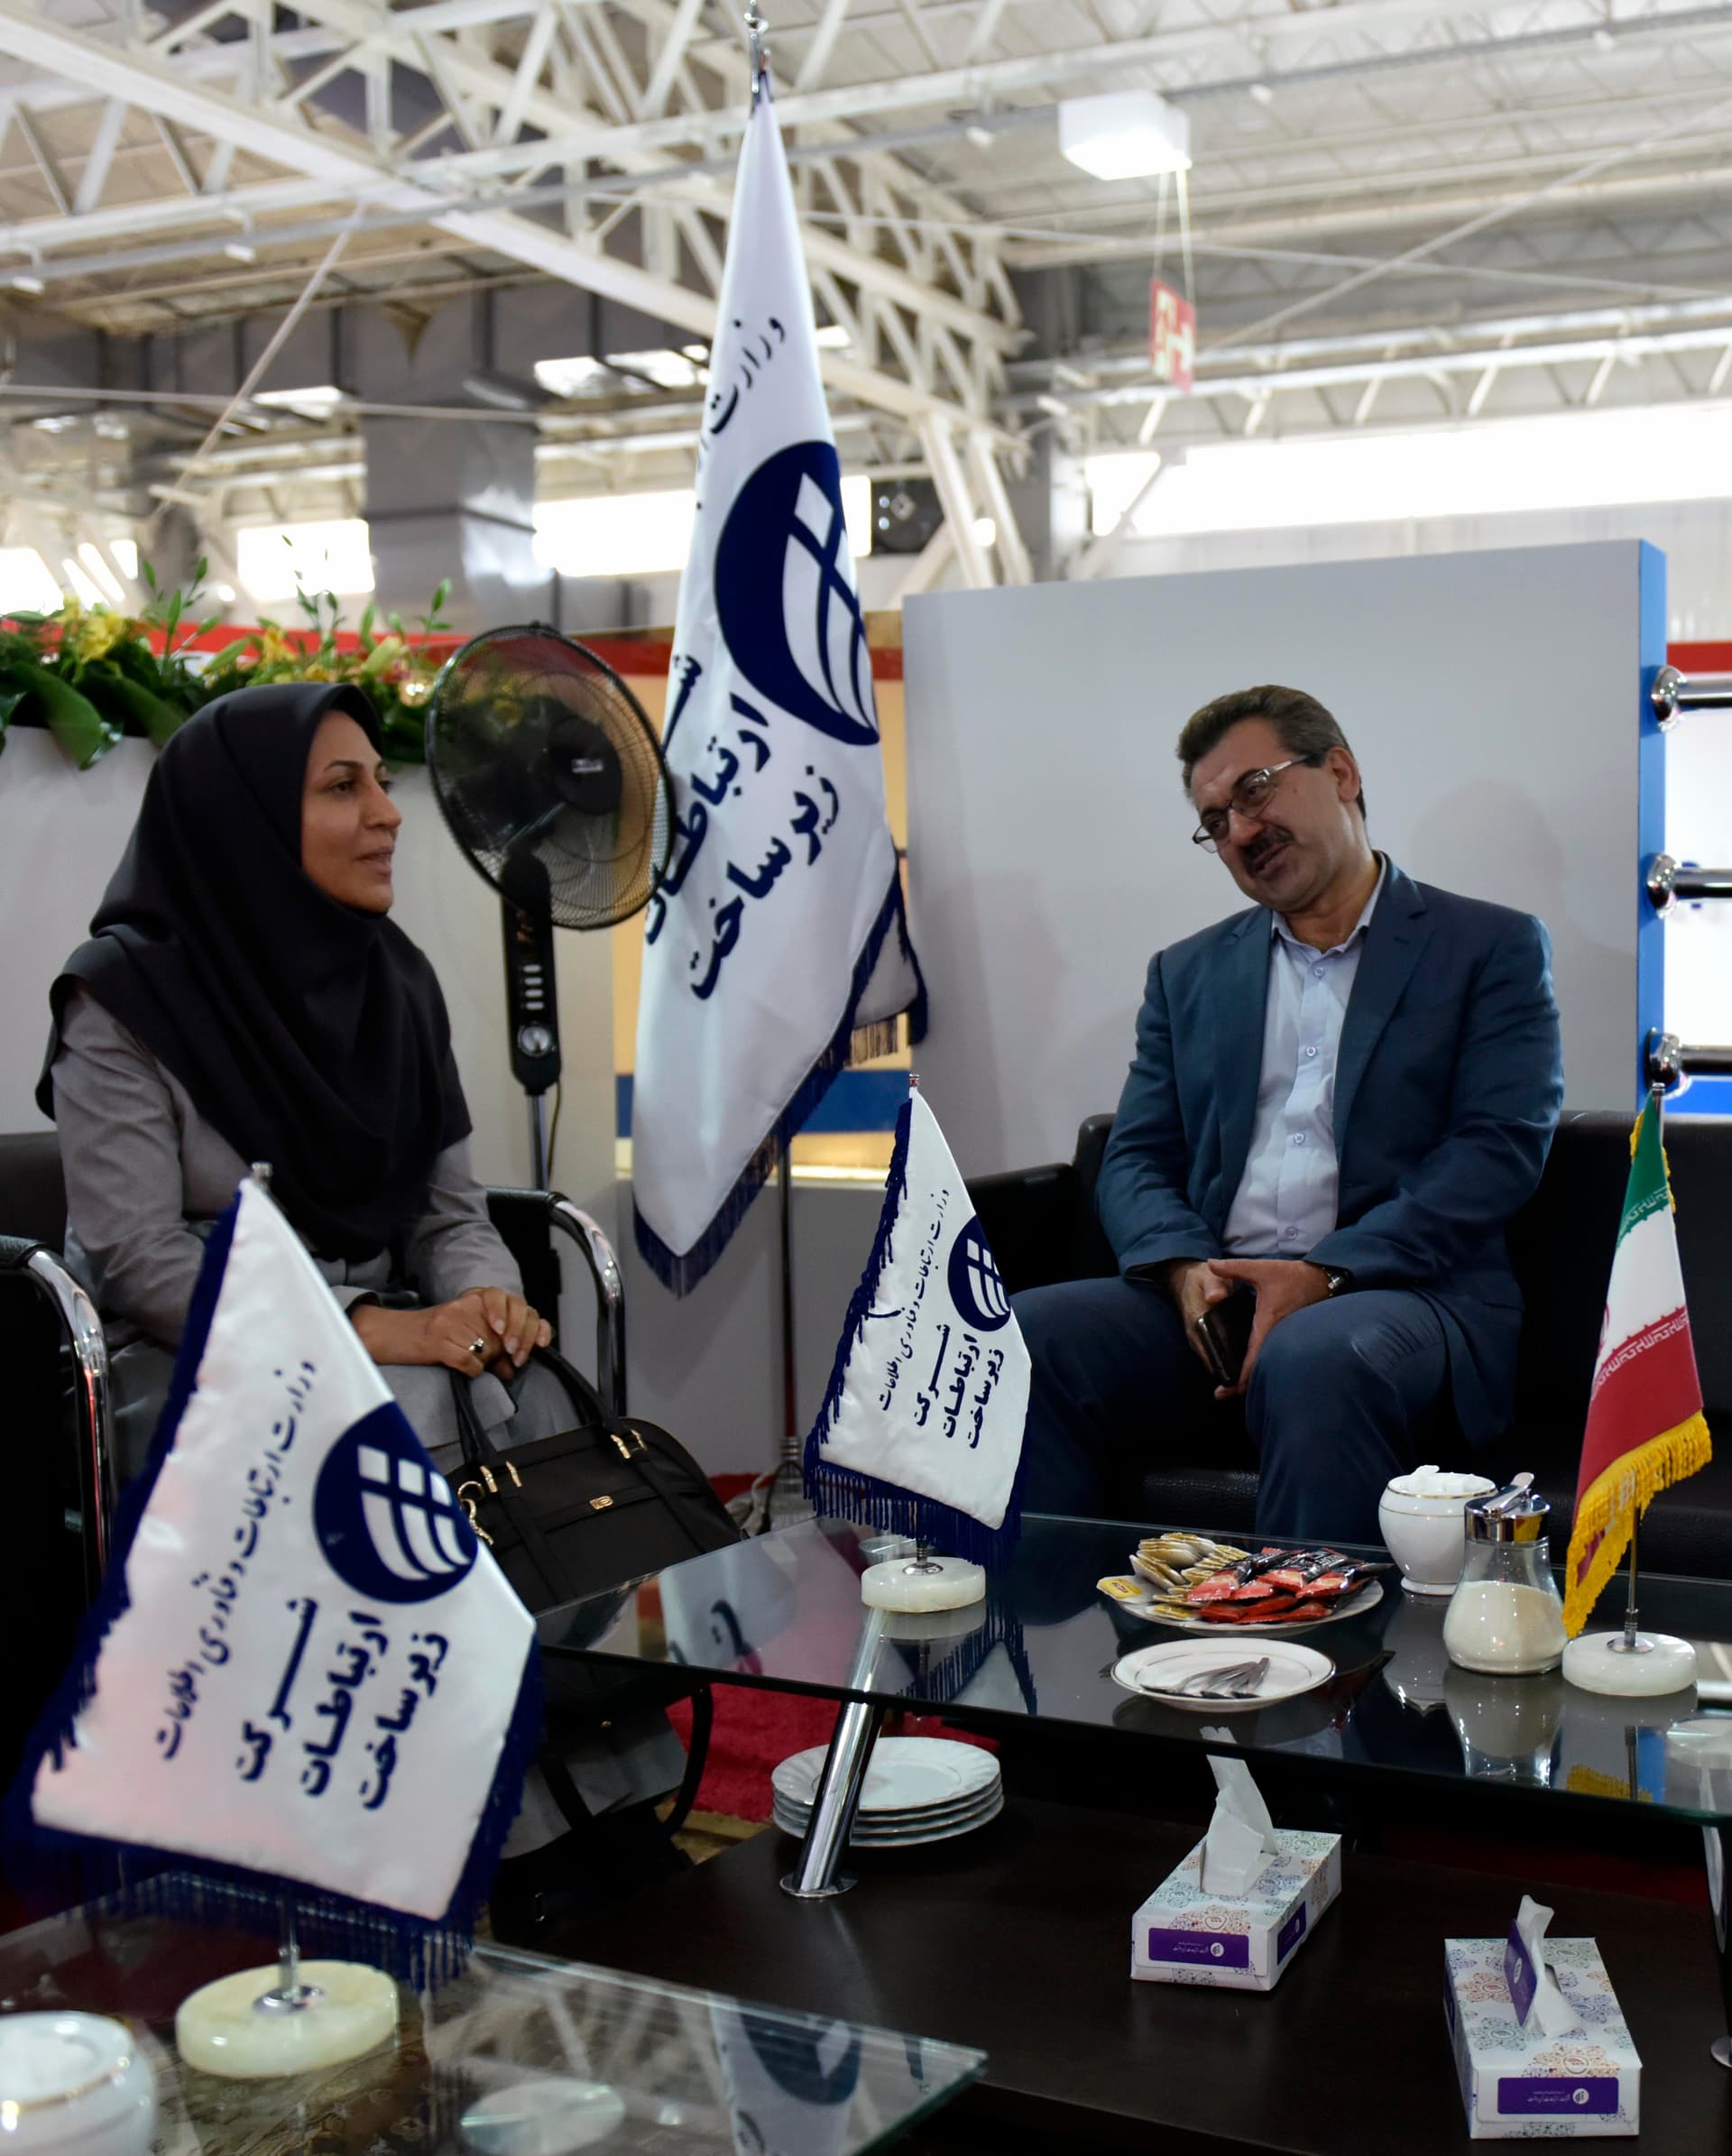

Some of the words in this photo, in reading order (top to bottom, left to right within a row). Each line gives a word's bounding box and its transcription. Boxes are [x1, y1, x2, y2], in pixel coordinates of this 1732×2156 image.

[709, 317, 788, 435] وزارت
[690, 765, 839, 1000] زیرساخت
[930, 1189, 950, 1240] وزارت
[915, 1239, 939, 1300] ارتباطات
[273, 1360, 317, 1452] وزارت
[880, 1356, 903, 1411] اطلاعات
[914, 1323, 951, 1427] شرکت
[943, 1333, 981, 1438] ارتباطات
[967, 1349, 1004, 1449] زیرساخت
[234, 1451, 292, 1559] ارتباطات
[155, 1661, 206, 1761] اطلاعات
[233, 1597, 318, 1783] شرکت
[299, 1610, 389, 1798] ارتباطات
[358, 1632, 450, 1811] زیرساخت
